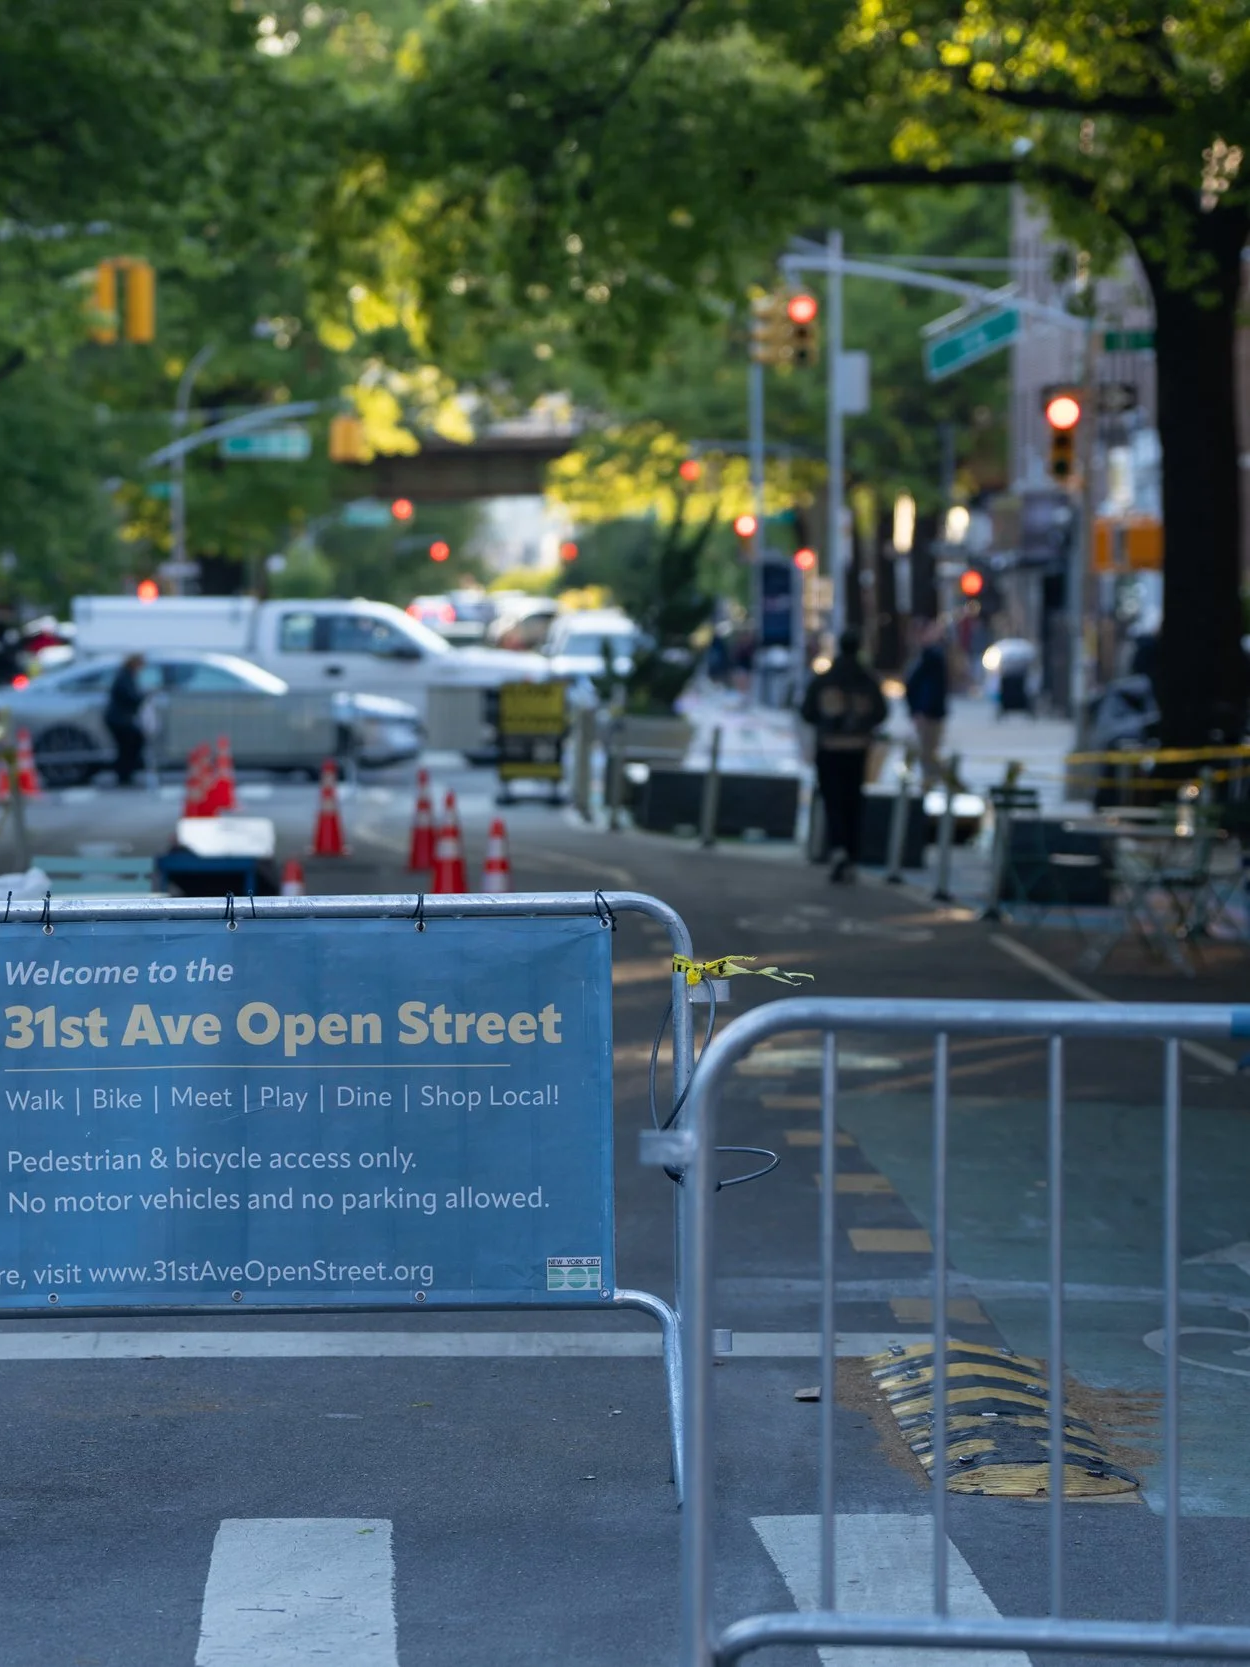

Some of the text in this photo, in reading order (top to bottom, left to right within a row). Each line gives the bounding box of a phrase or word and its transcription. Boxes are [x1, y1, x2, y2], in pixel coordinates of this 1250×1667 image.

[5, 957, 234, 985] Welcome to the
[4, 1001, 562, 1057] 31st Ave Open Street
[5, 1084, 559, 1113] Walk Bike Meet Play Dine Shop Local!
[7, 1146, 417, 1174] Pedestrian & bicycle access only.
[9, 1186, 550, 1216] No motor vehicles and no parking allowed.
[33, 1263, 82, 1285] visit
[88, 1260, 434, 1287] www.31stAveOpenStreet.org
